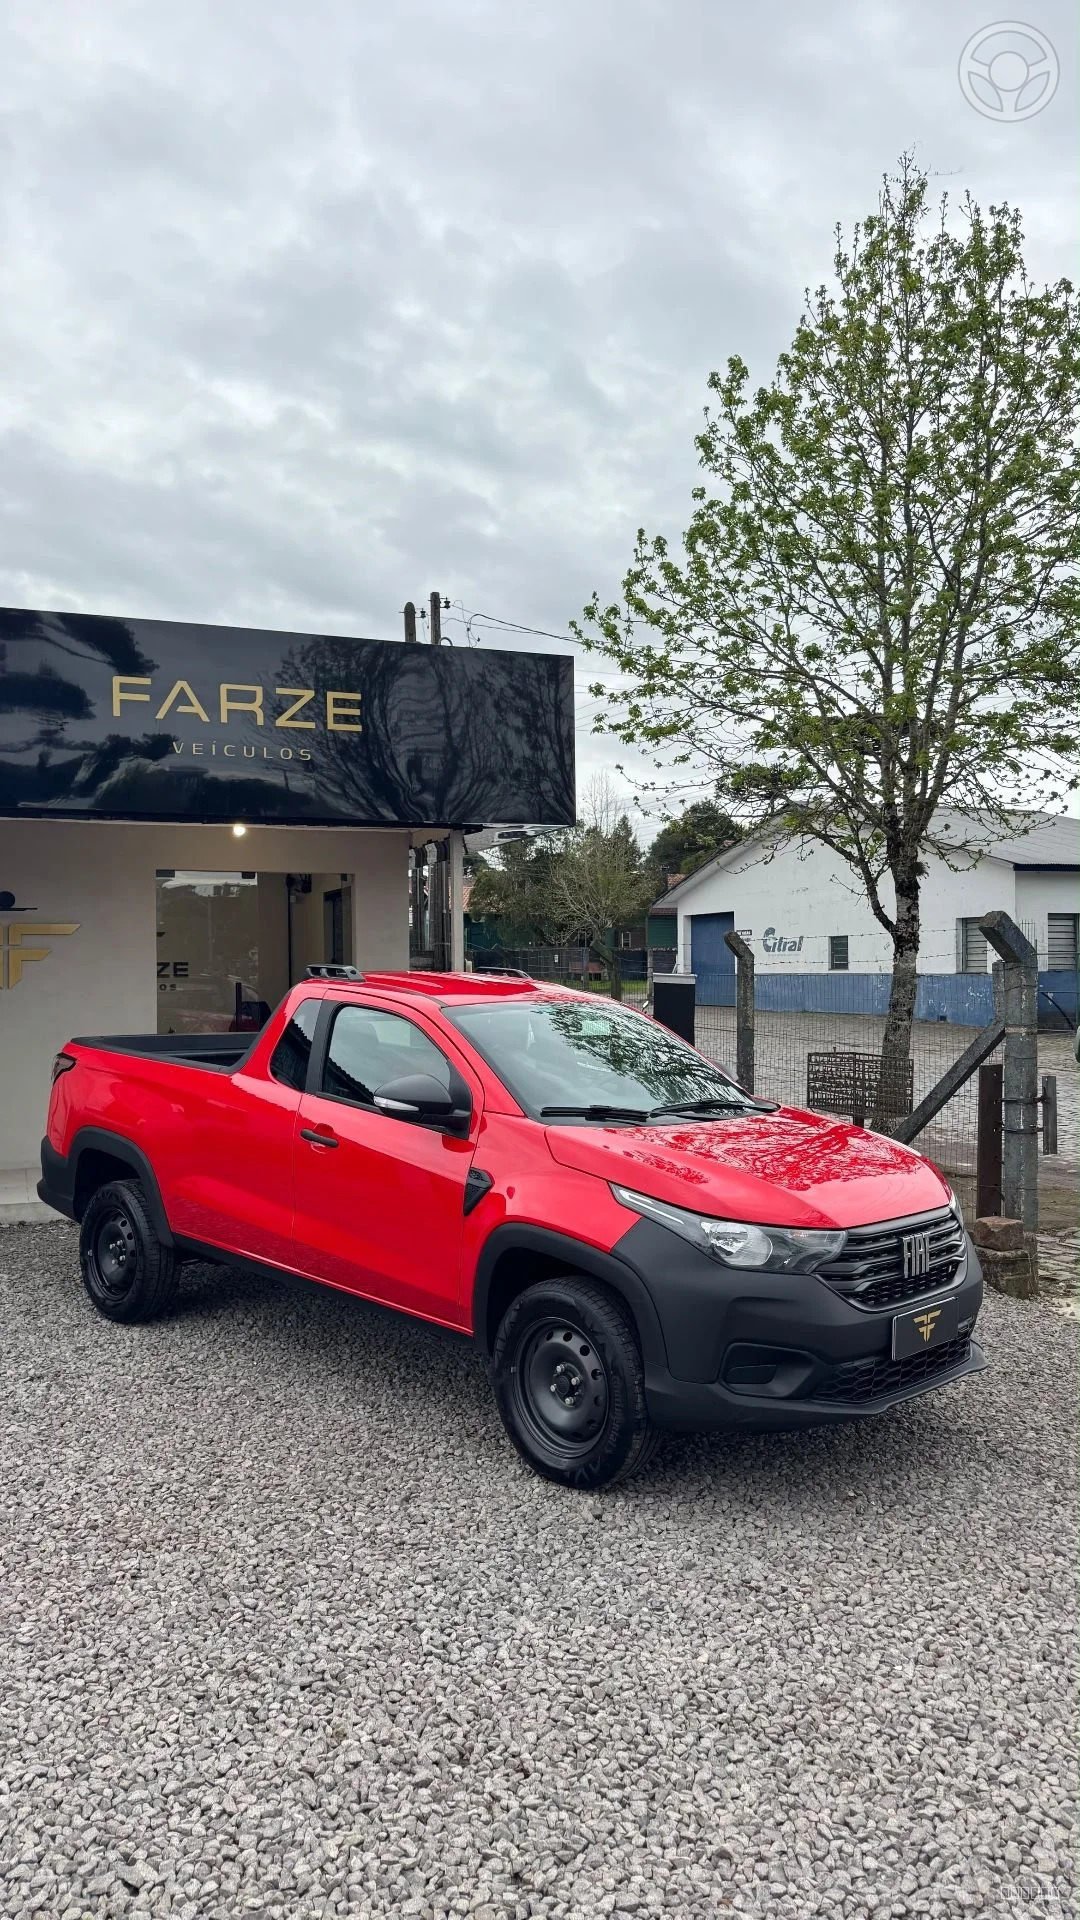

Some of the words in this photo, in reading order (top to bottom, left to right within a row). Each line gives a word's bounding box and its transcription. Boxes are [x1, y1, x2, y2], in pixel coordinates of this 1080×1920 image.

[112, 676, 363, 732] FARZE
[172, 741, 312, 762] VEÍCULOS
[763, 927, 804, 952] Citral
[902, 1232, 930, 1278] FIAT
